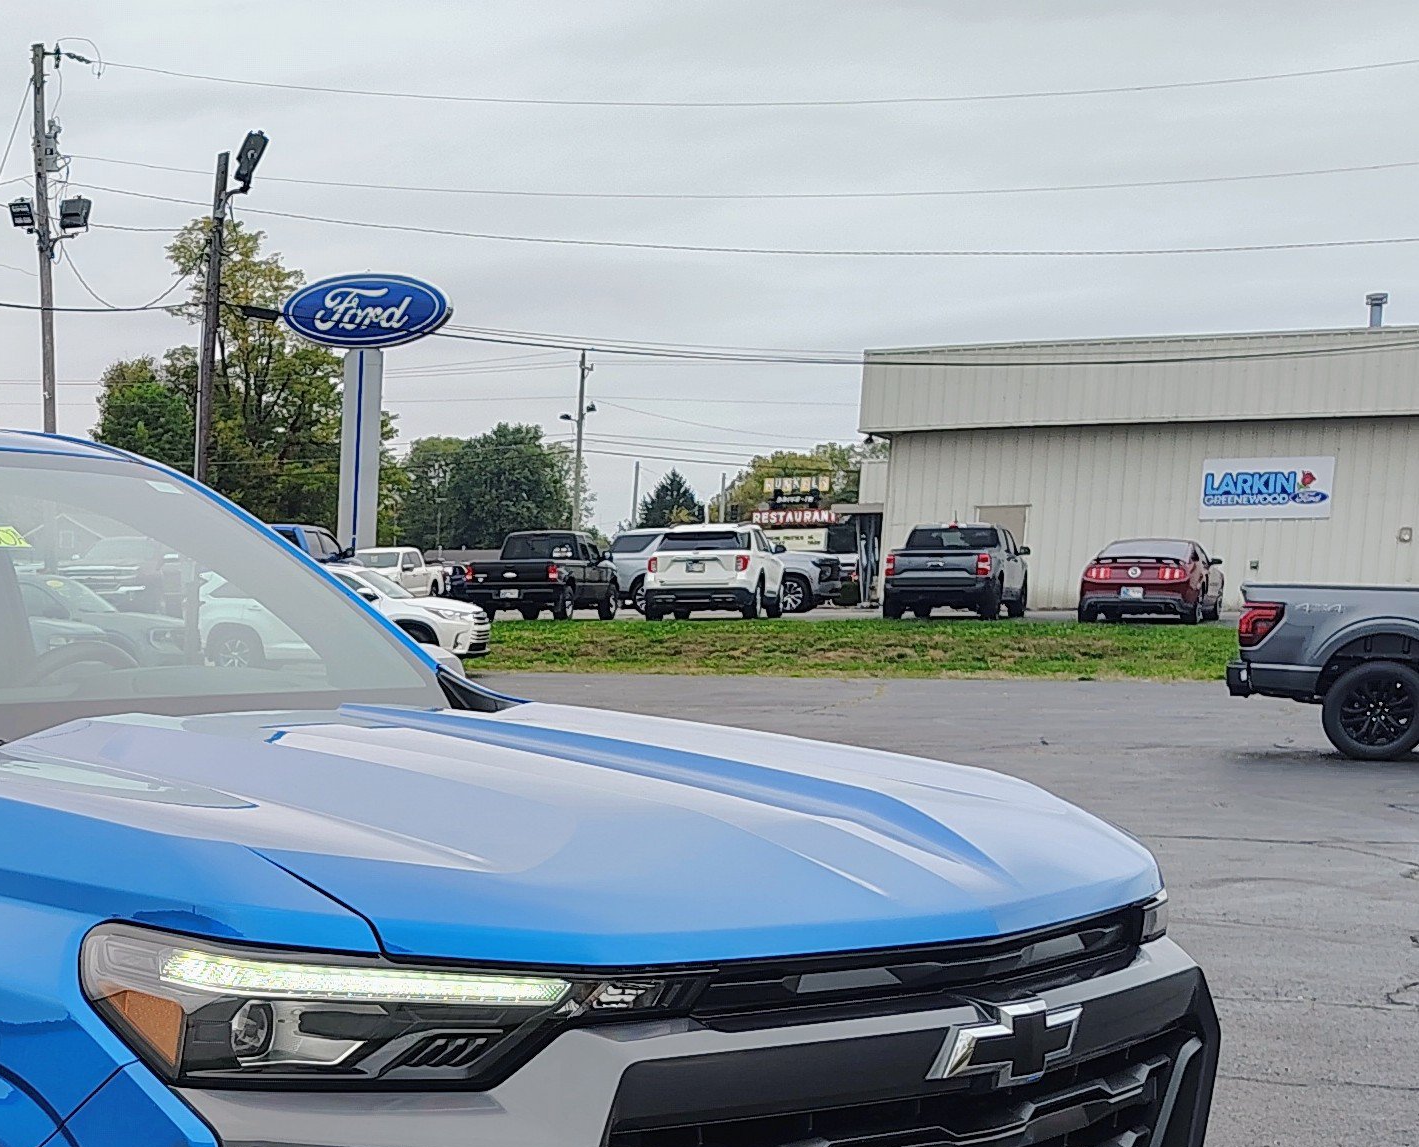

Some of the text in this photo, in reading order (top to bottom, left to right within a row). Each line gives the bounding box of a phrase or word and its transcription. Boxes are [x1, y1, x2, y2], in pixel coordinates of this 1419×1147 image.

[314, 287, 413, 331] Ford
[1203, 471, 1297, 495] LARKIN
[752, 509, 836, 523] RESTAURANT
